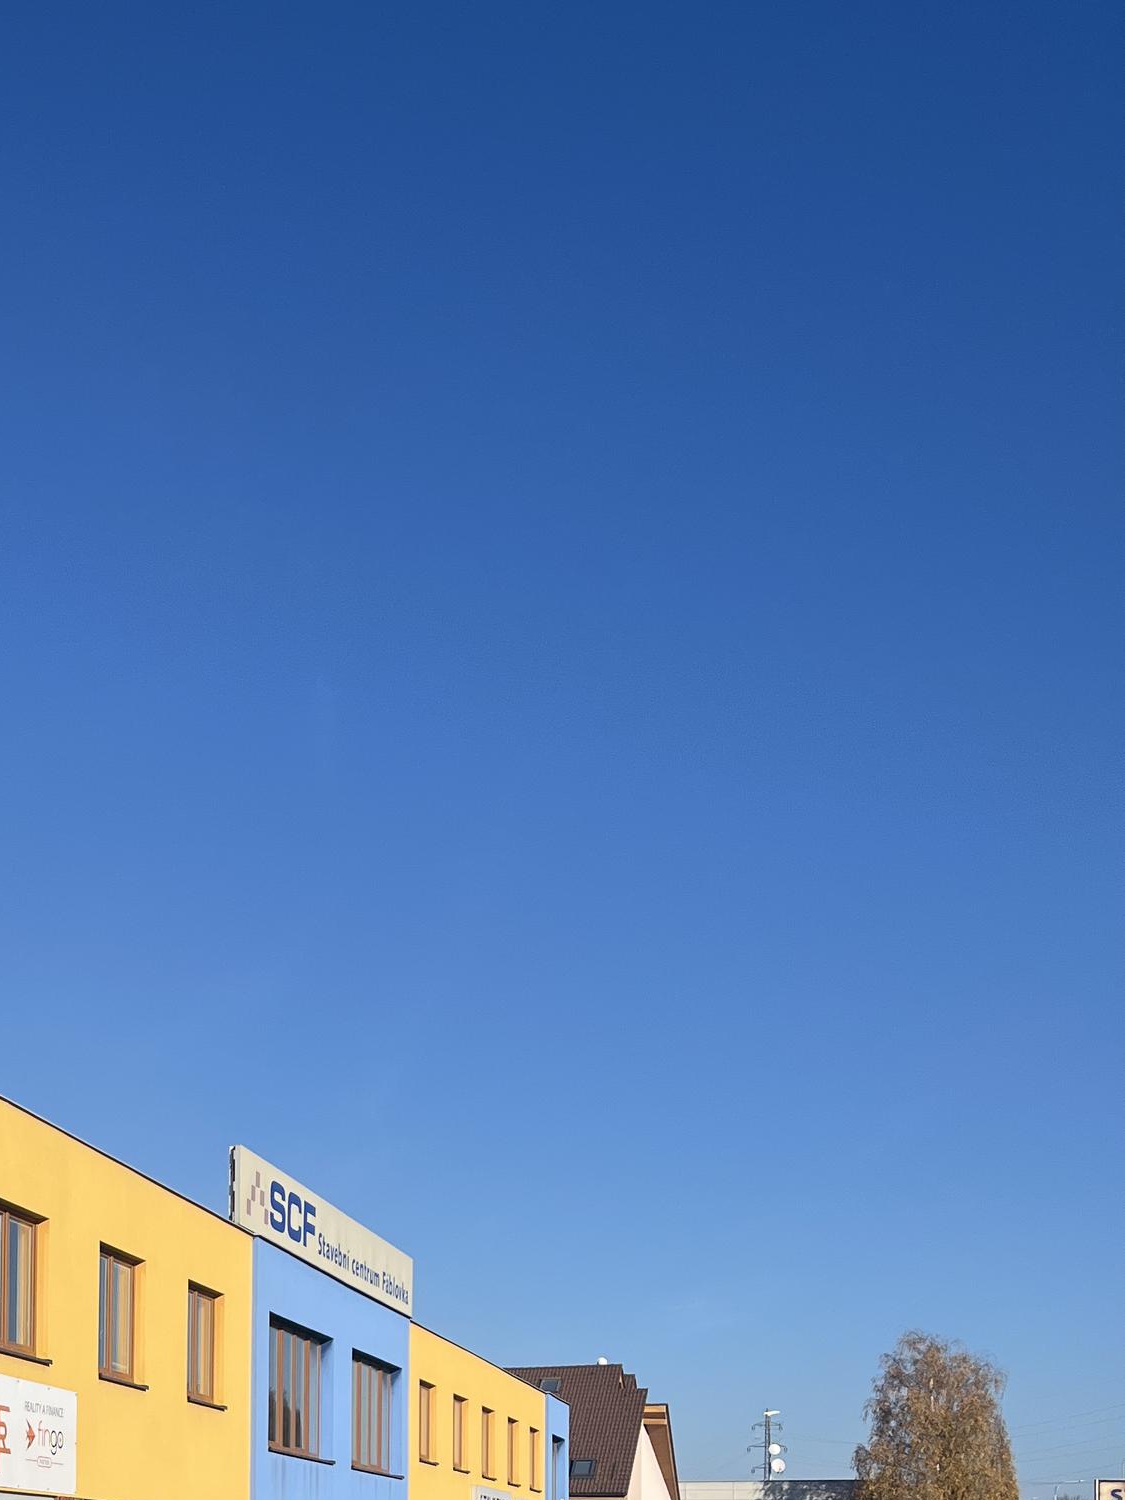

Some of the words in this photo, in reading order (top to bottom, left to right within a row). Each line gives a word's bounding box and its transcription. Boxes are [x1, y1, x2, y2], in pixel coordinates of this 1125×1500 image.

[269, 1180, 317, 1248] SCF
[351, 1257, 380, 1287] centrum
[37, 1420, 64, 1455] fingo
